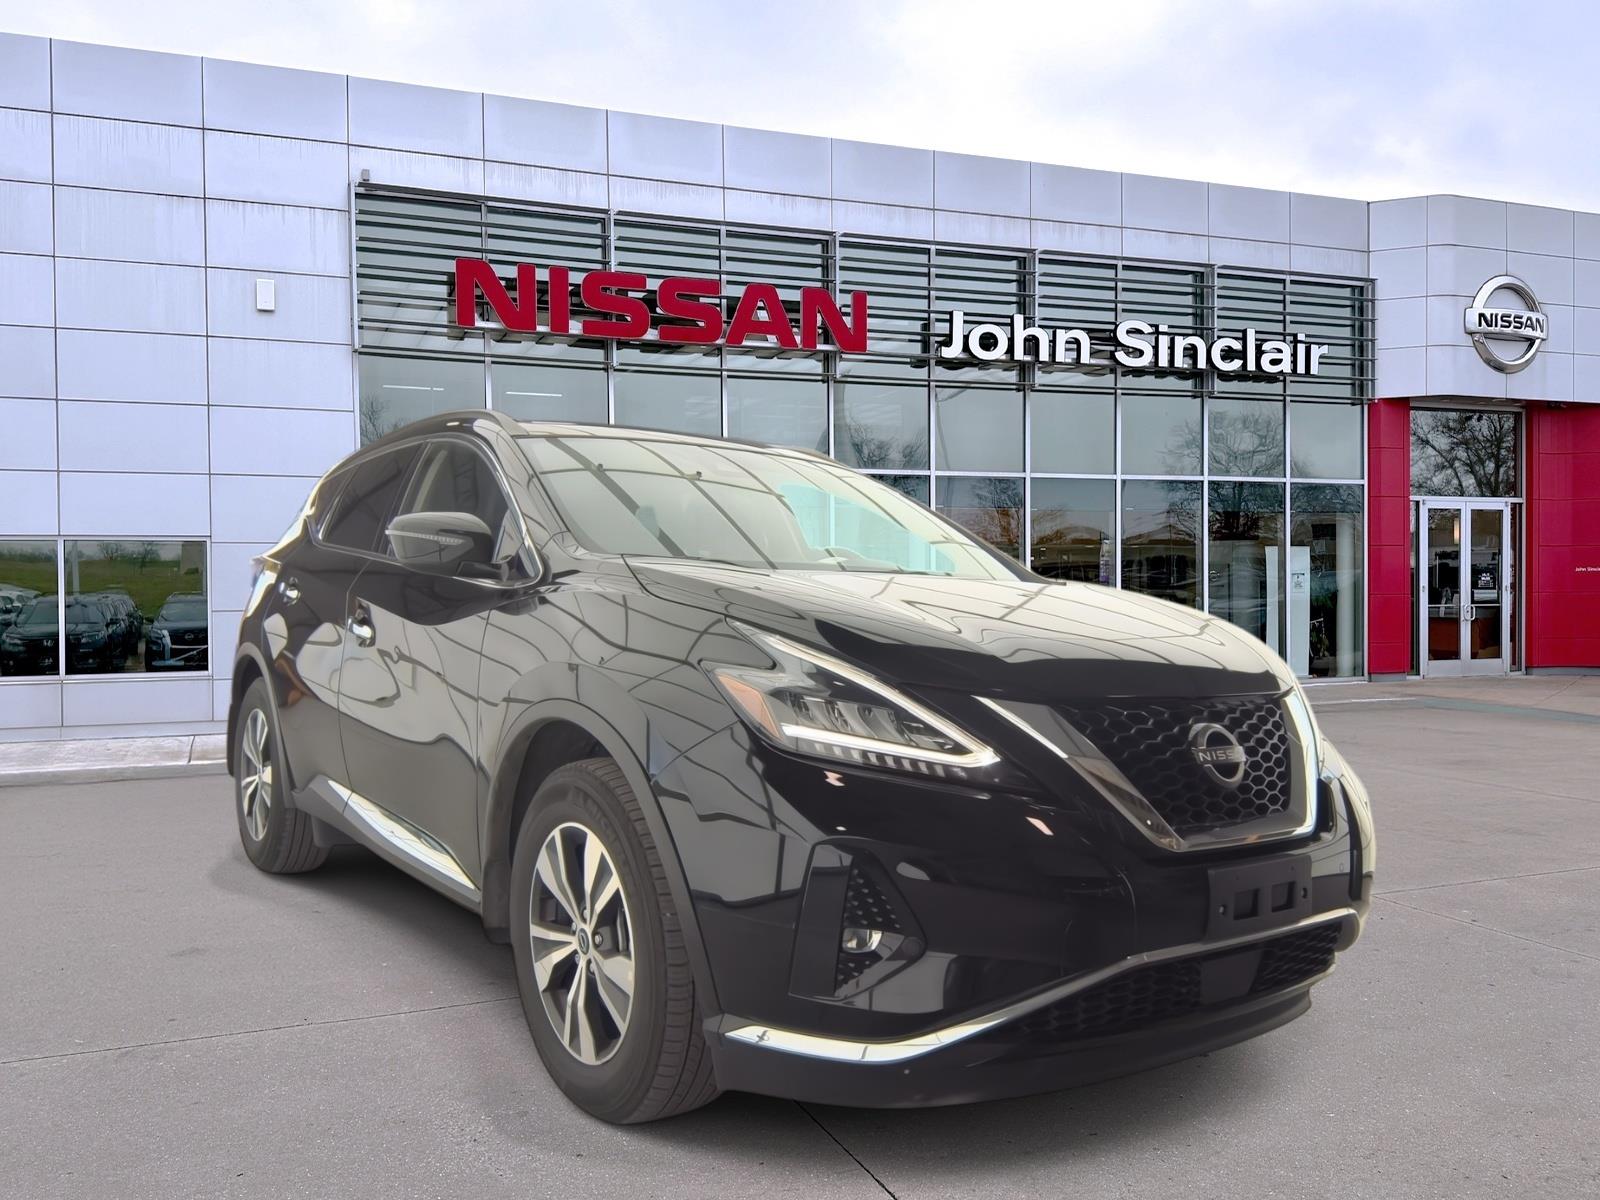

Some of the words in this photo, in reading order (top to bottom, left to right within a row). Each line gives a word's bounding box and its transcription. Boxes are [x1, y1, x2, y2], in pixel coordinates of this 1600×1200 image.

[454, 257, 868, 353] NISSAN
[1478, 312, 1545, 333] NISSAN
[941, 310, 1090, 364] John
[1114, 319, 1329, 375] Sinclair
[1198, 750, 1241, 762] NISS
